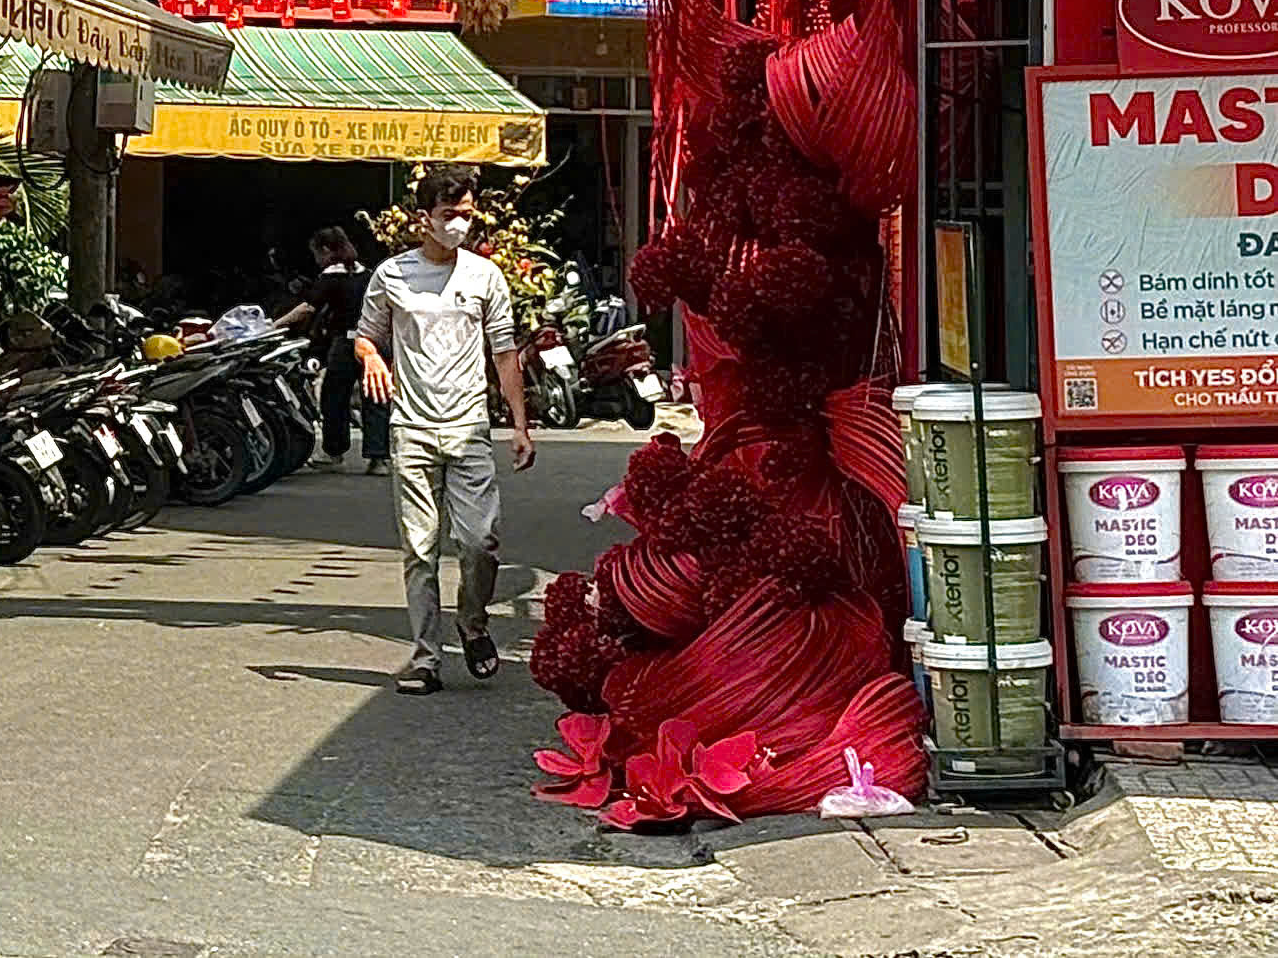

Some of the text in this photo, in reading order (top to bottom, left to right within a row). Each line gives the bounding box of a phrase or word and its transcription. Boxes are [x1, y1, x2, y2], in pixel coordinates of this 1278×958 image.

[256, 118, 290, 139] QUY
[310, 117, 330, 140] TÔ
[346, 122, 369, 141] XE
[372, 119, 409, 141] MÁY
[313, 143, 341, 156] XE
[1139, 267, 1275, 292] Bám dính tốt
[1140, 297, 1168, 319] Bề
[1173, 299, 1216, 323] mặt
[1220, 298, 1266, 320] láng
[1141, 327, 1270, 354] Hạn chế nứt
[1133, 365, 1187, 387] TÍCH
[1191, 368, 1236, 386] YES
[1173, 392, 1211, 406] CHO
[1094, 517, 1157, 532] MASTIC
[1106, 619, 1160, 637] KOVA
[1103, 654, 1166, 668] MASTIC
